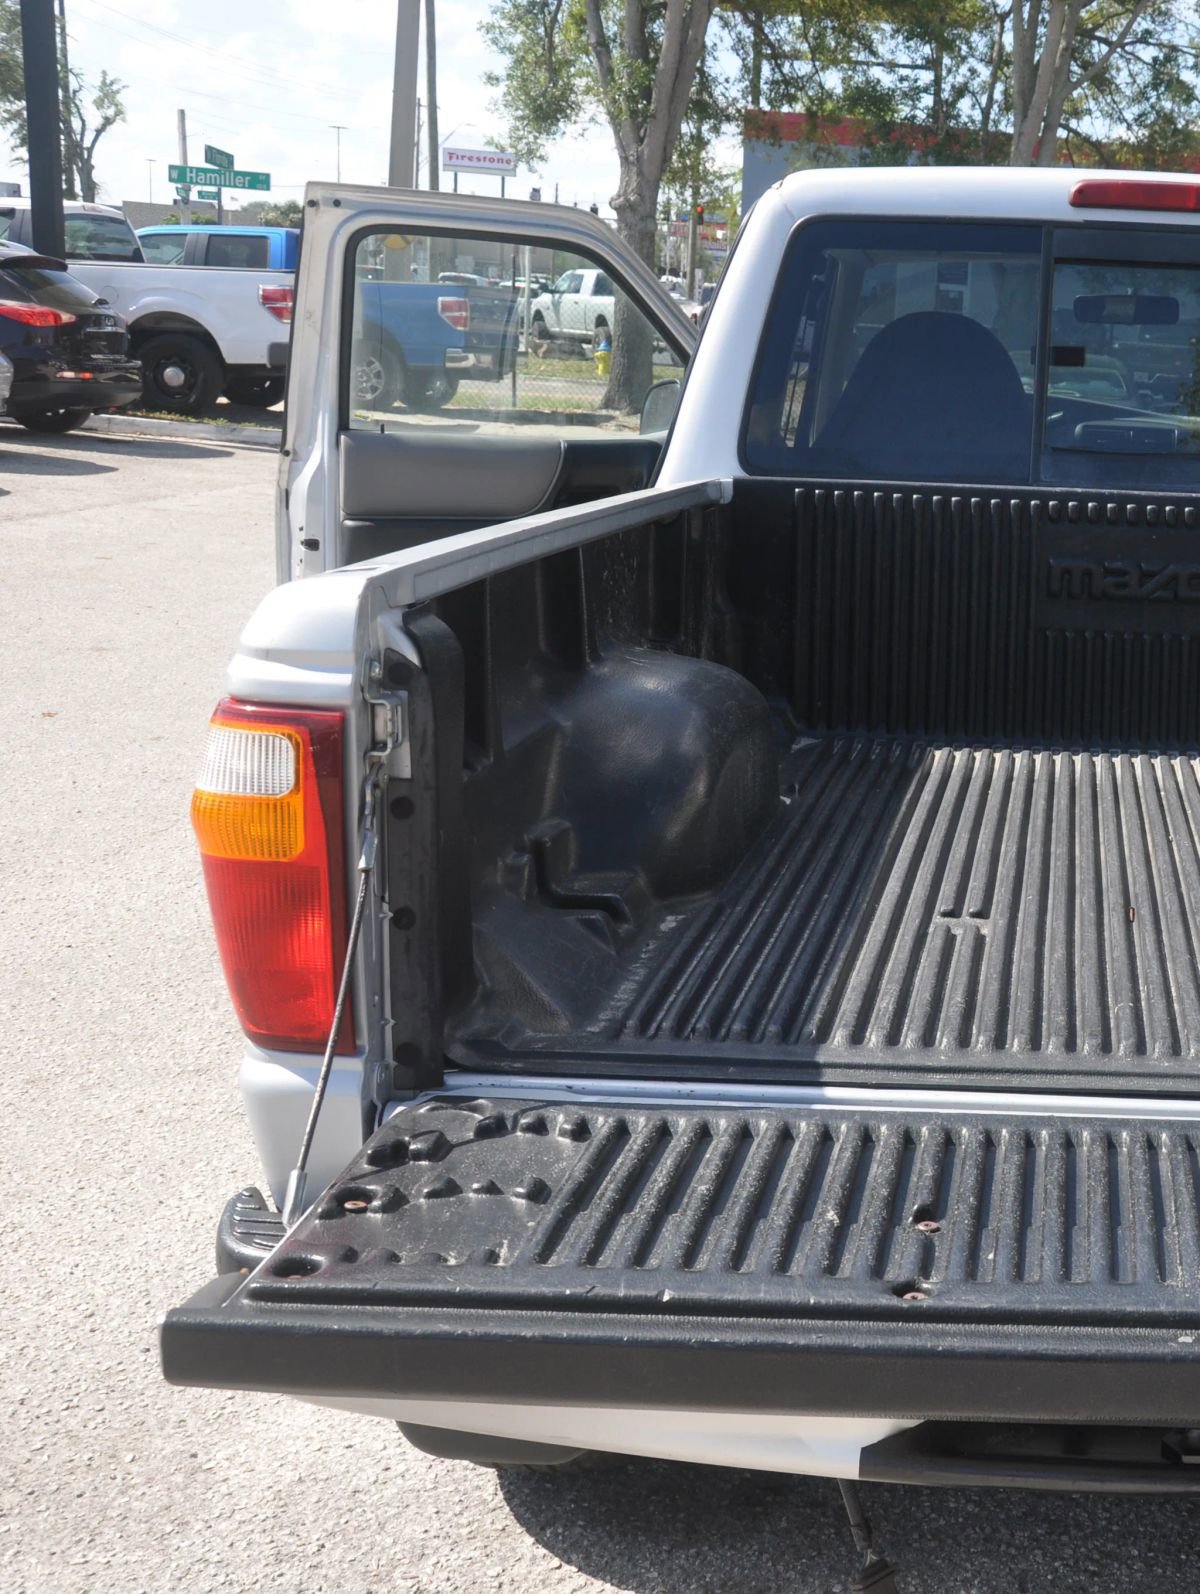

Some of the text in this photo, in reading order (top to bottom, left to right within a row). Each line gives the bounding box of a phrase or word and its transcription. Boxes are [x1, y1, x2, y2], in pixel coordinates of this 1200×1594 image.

[447, 151, 512, 165] Firestone
[170, 169, 178, 180] W
[186, 167, 252, 188] Hamiller
